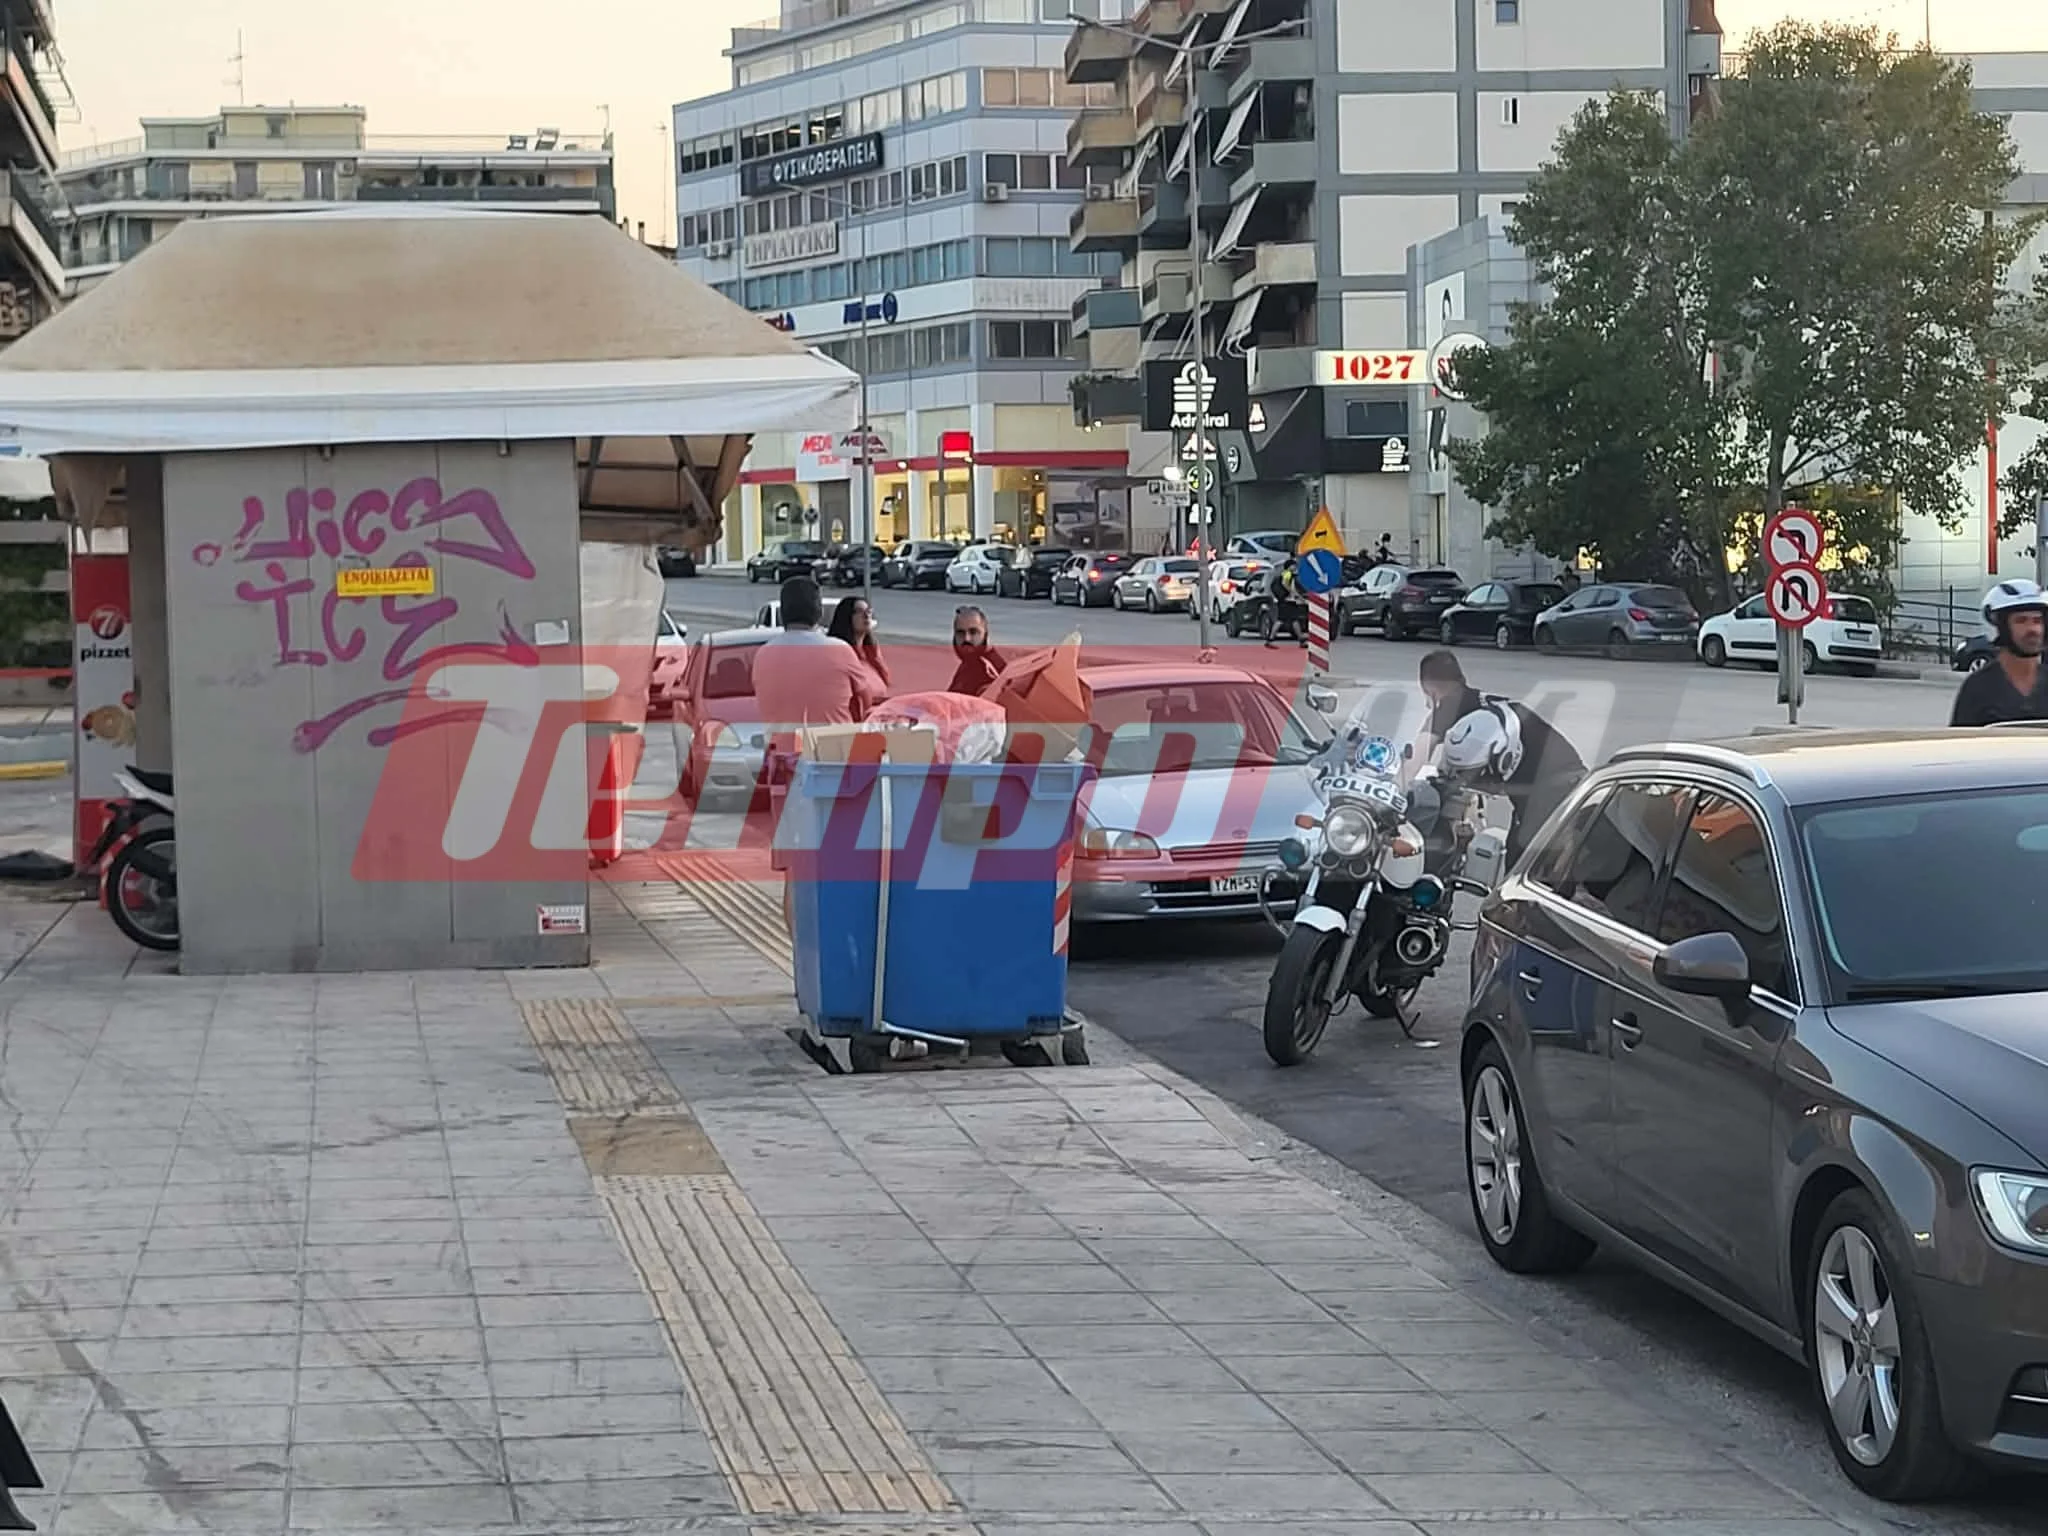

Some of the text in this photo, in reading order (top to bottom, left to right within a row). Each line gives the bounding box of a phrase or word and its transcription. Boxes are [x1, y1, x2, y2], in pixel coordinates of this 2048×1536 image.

[773, 139, 878, 182] ΦΥΣΙΚΟΘΕΡΑΠΕΙΑ
[1332, 355, 1415, 381] 1027
[1320, 777, 1407, 812] POLICE
